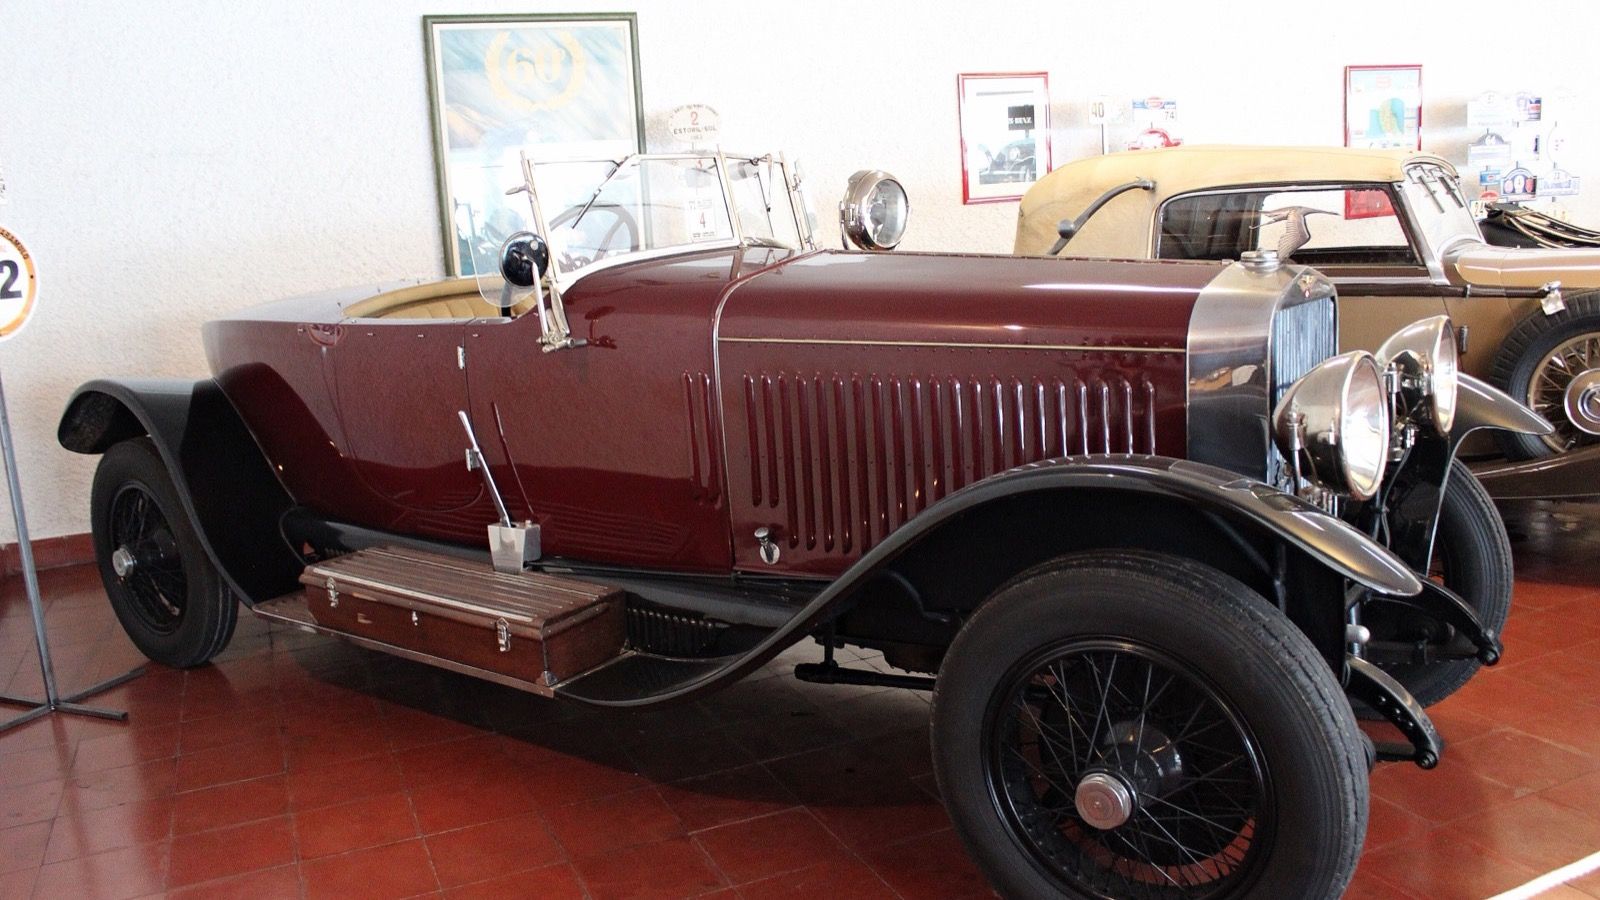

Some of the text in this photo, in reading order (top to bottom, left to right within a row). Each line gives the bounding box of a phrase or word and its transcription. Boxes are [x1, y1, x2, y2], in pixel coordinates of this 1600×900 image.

[507, 46, 563, 84] 60
[690, 111, 699, 126] 2
[1091, 102, 1104, 118] 40
[699, 211, 706, 229] 4
